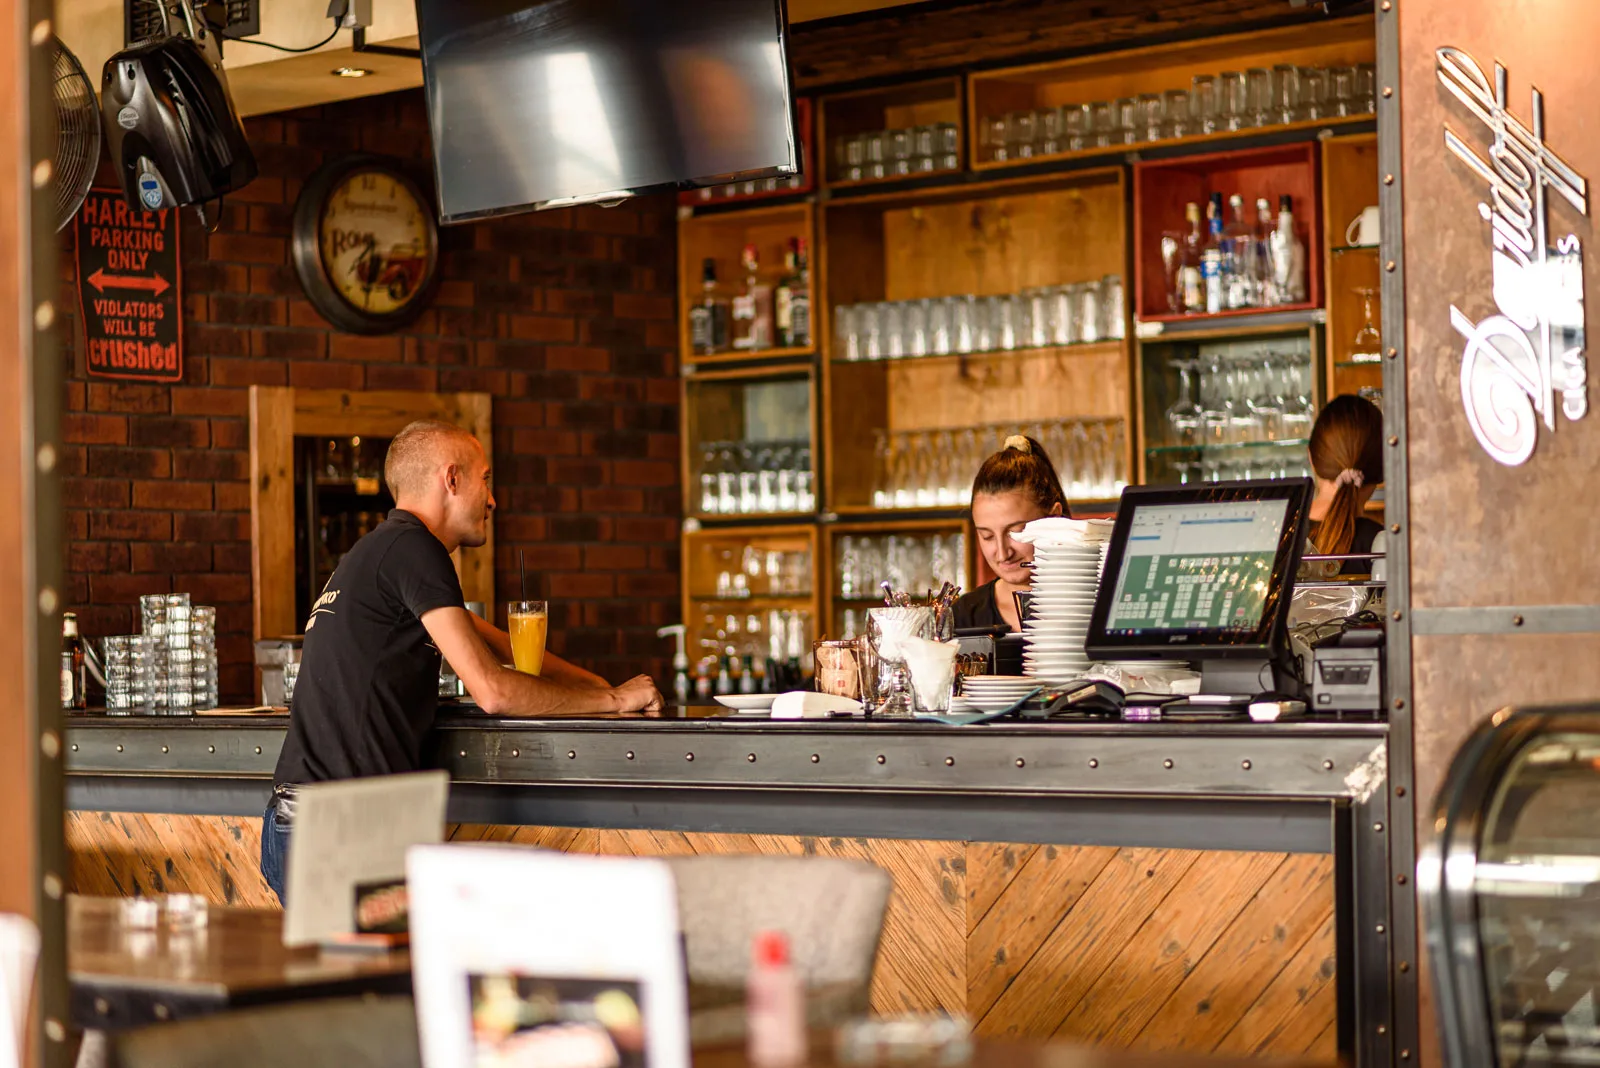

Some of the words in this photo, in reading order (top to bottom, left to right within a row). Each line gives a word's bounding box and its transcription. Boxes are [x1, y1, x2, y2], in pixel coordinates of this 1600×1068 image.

[83, 197, 169, 231] HARLEY
[91, 227, 165, 252] PARKING
[107, 250, 149, 271] ONLY
[93, 299, 165, 320] VIOLATORS
[103, 318, 136, 337] WILL
[139, 320, 156, 337] BE
[89, 337, 177, 371] crushed
